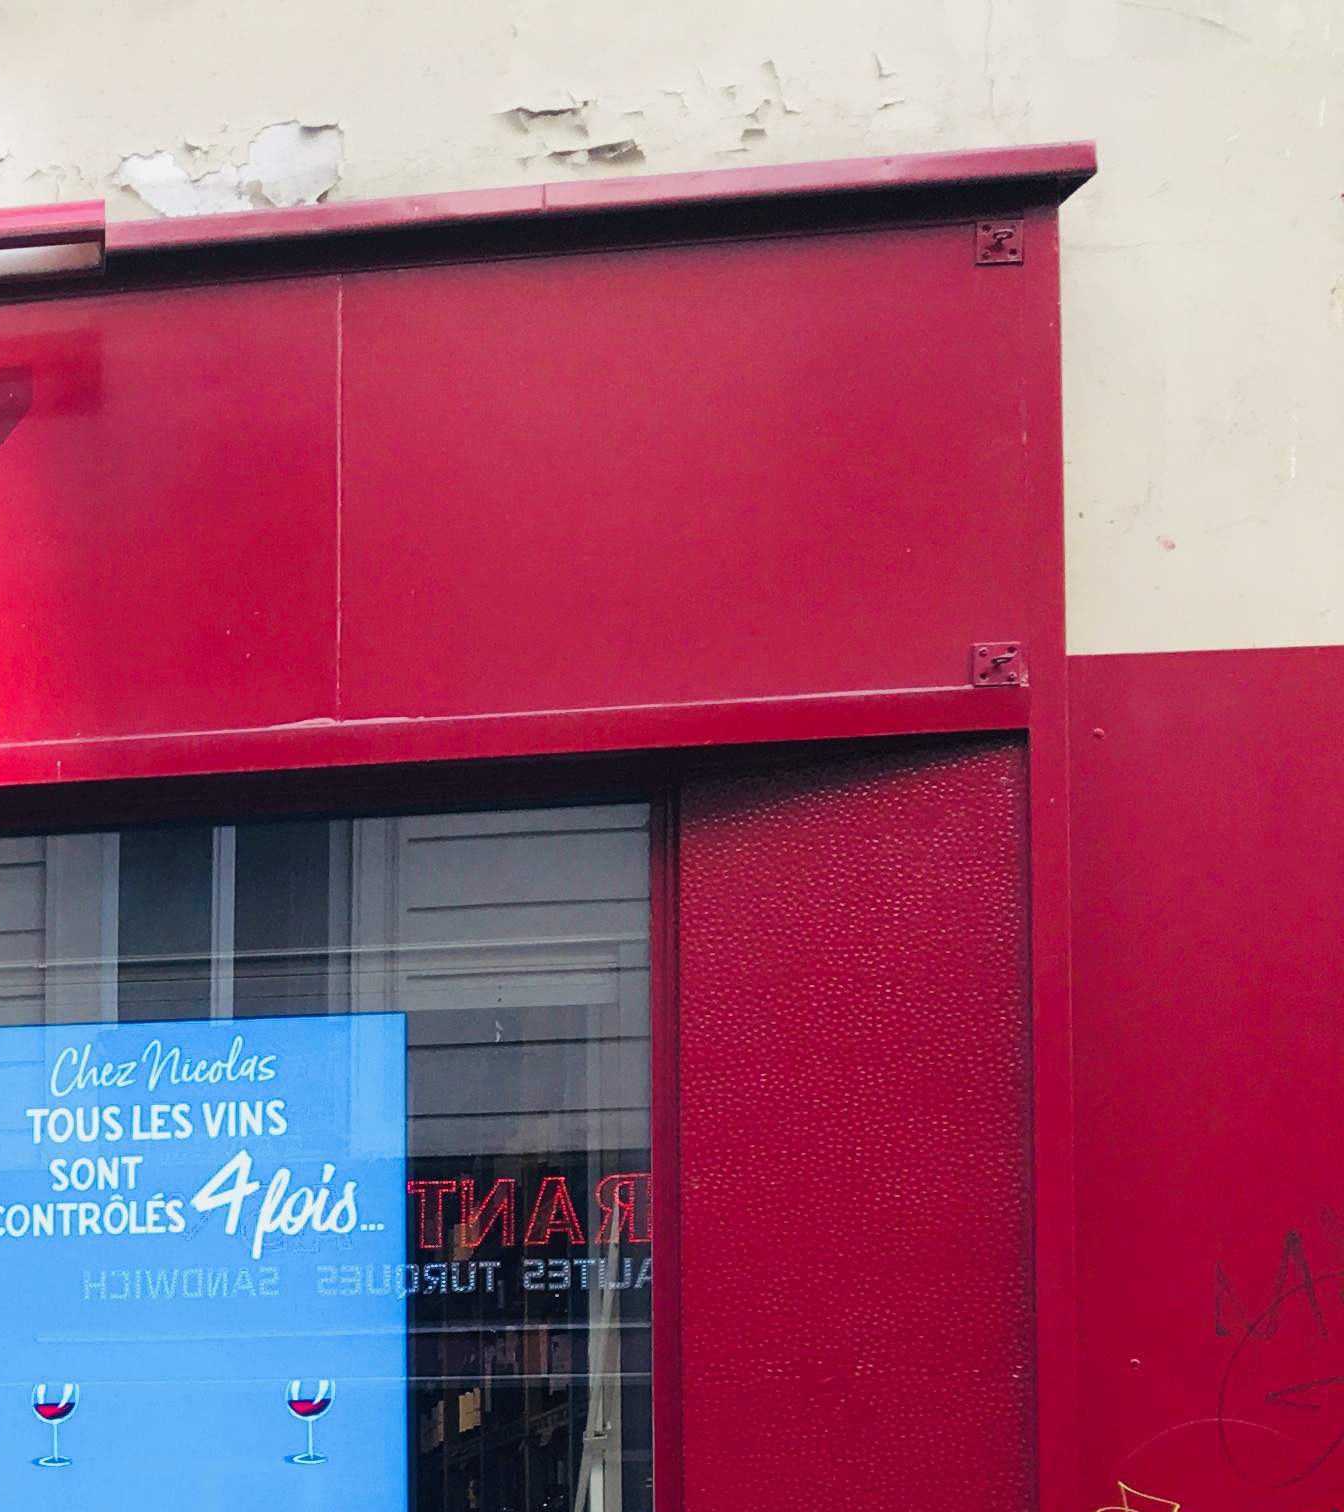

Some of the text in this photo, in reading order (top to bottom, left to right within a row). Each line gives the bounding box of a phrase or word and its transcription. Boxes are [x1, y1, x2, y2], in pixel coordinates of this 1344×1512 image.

[50, 1035, 277, 1098] Chez Nicolas
[26, 1100, 288, 1144] TOUS LES VINS
[49, 1156, 143, 1191] SONT
[191, 1149, 260, 1235] 4
